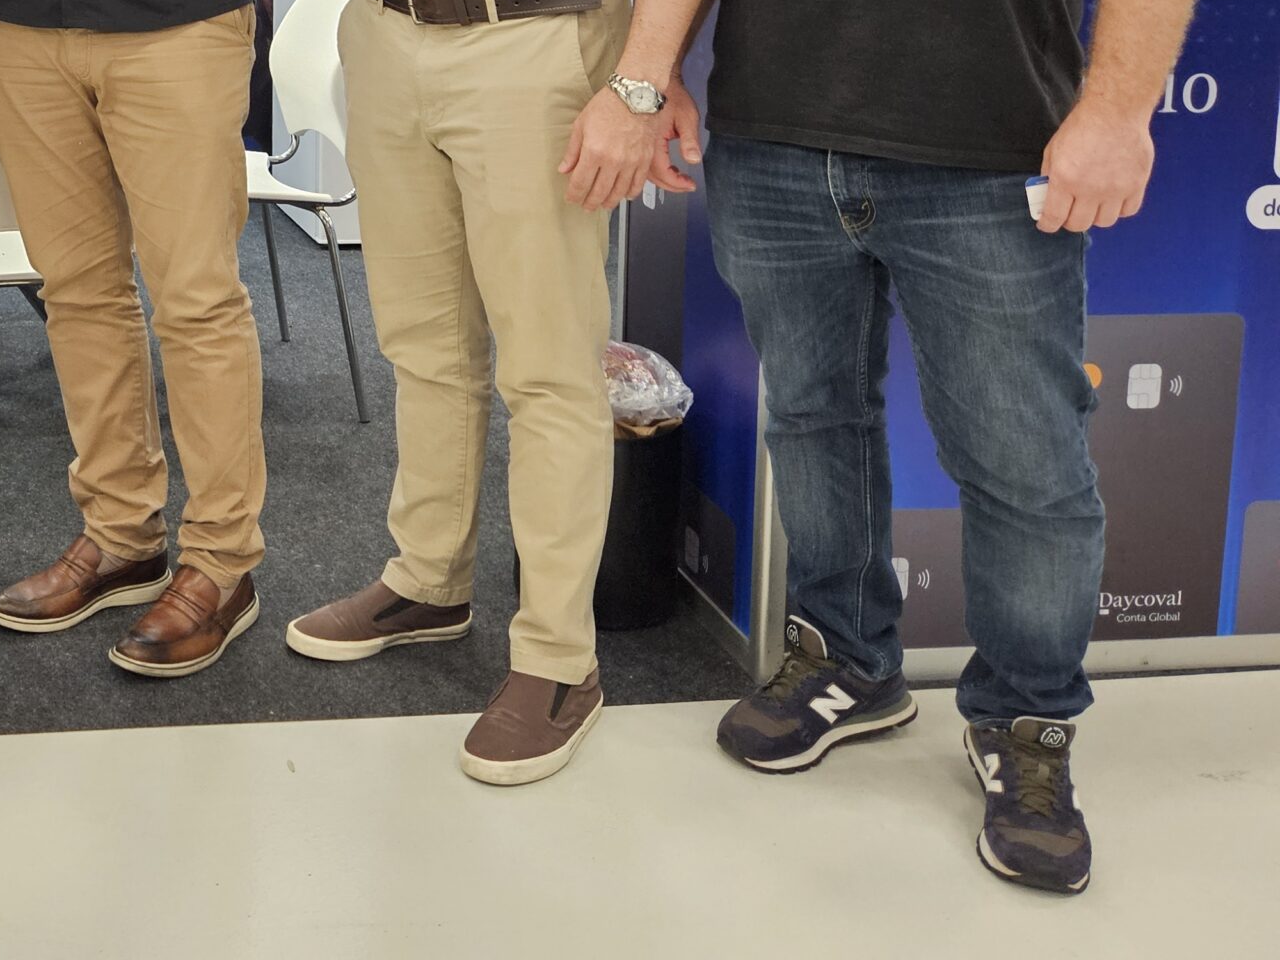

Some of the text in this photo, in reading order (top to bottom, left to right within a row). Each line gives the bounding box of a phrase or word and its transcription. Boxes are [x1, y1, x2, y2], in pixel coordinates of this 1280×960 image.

[1100, 590, 1182, 611] Daycoval
[1117, 612, 1180, 623] Conta Global
